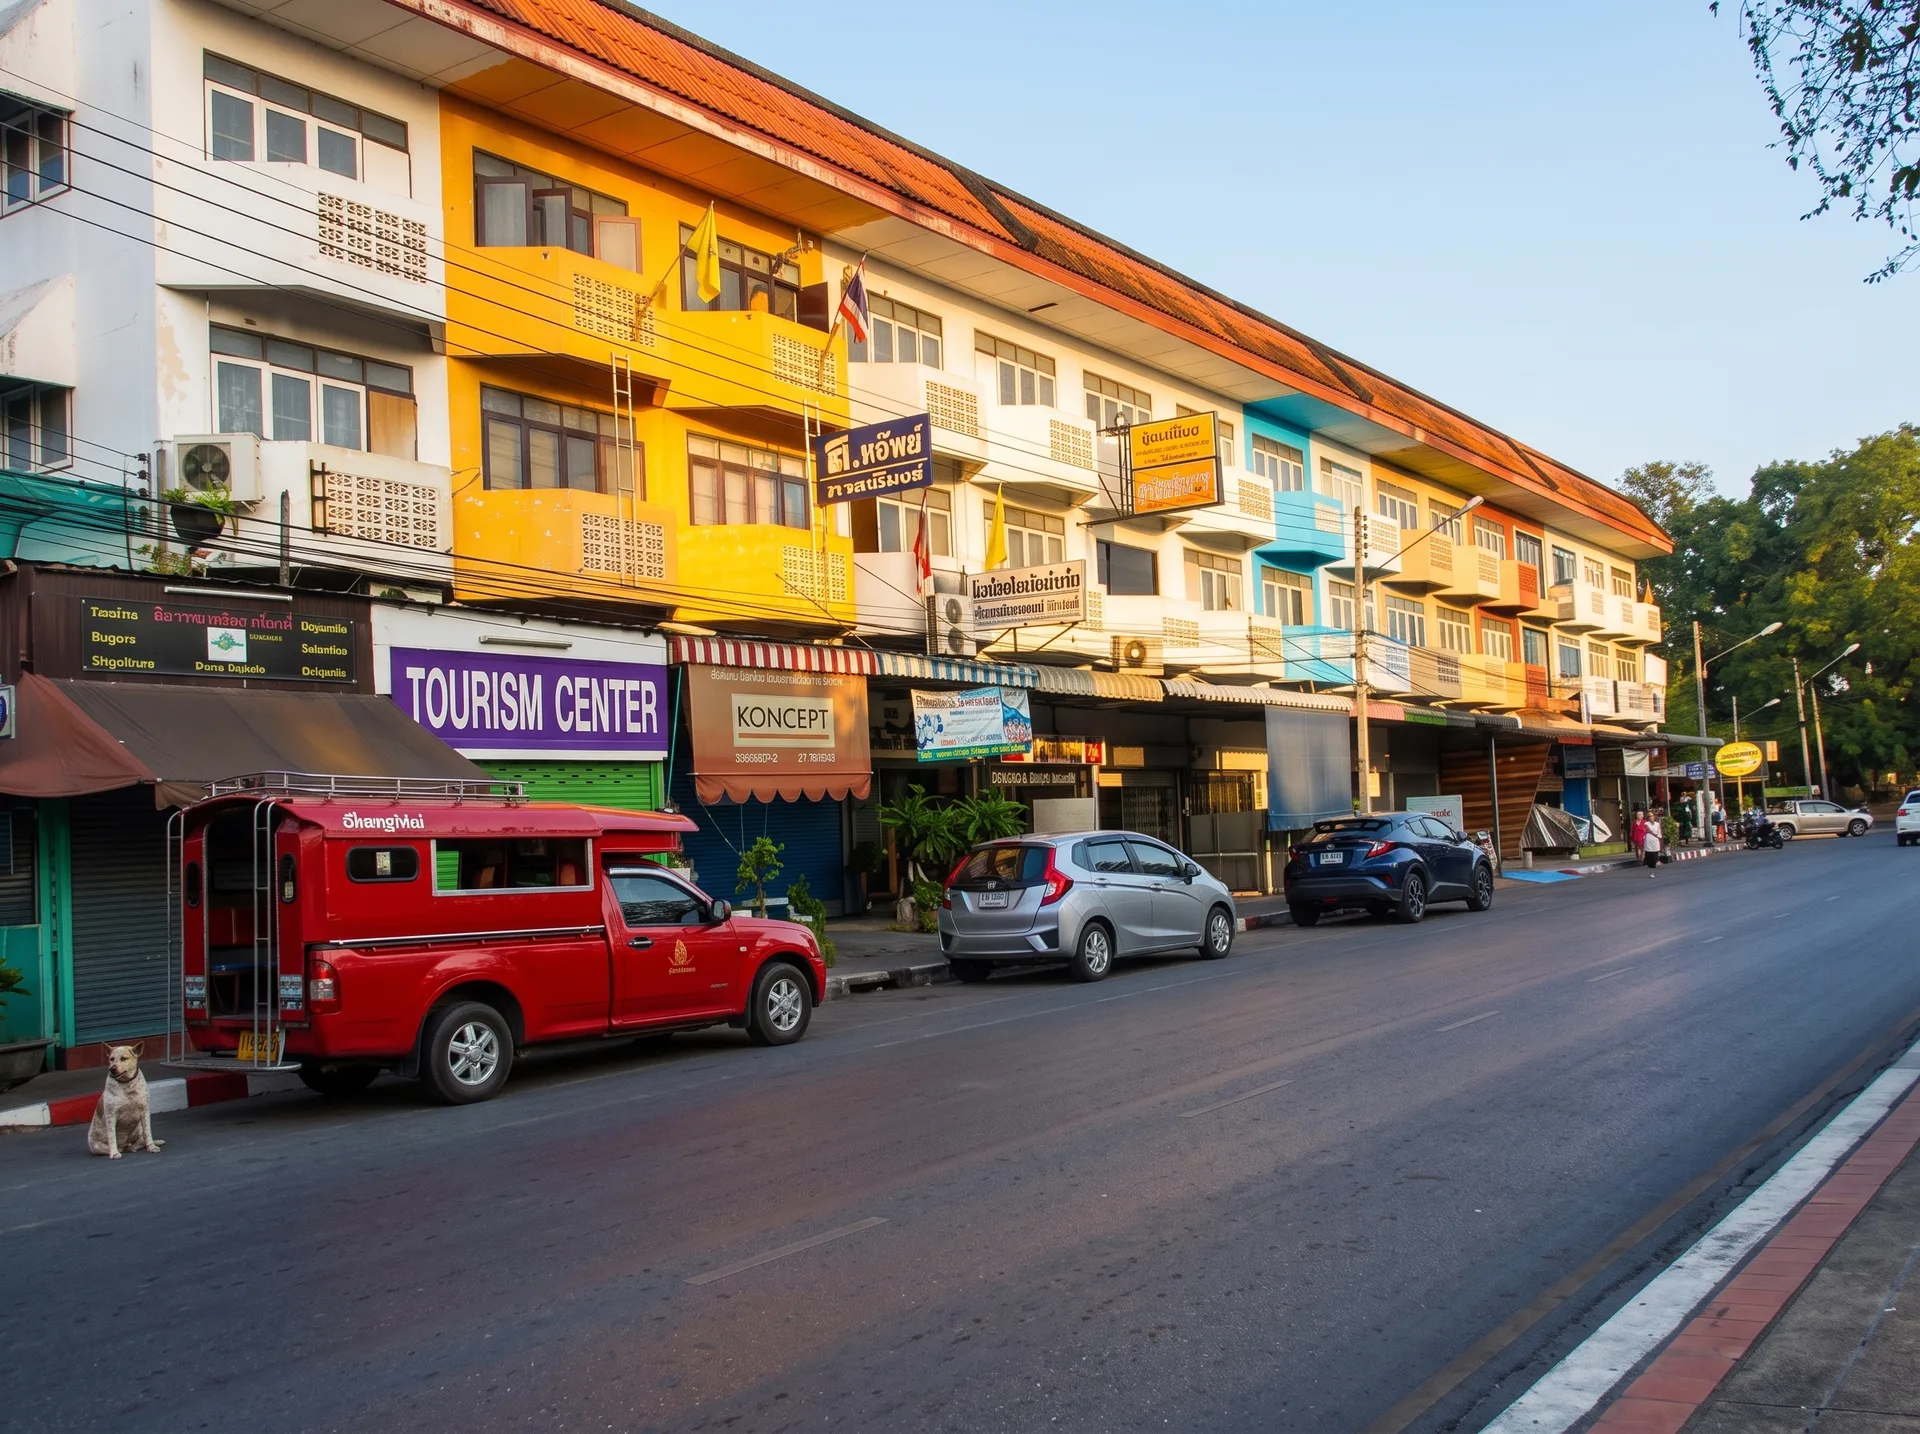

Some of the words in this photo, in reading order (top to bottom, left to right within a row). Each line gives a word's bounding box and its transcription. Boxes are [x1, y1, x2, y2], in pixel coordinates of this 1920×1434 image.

[91, 631, 136, 646] Bugors
[405, 666, 543, 731] TOURISM
[555, 675, 658, 734] CENTER
[737, 706, 829, 729] KONCEPT
